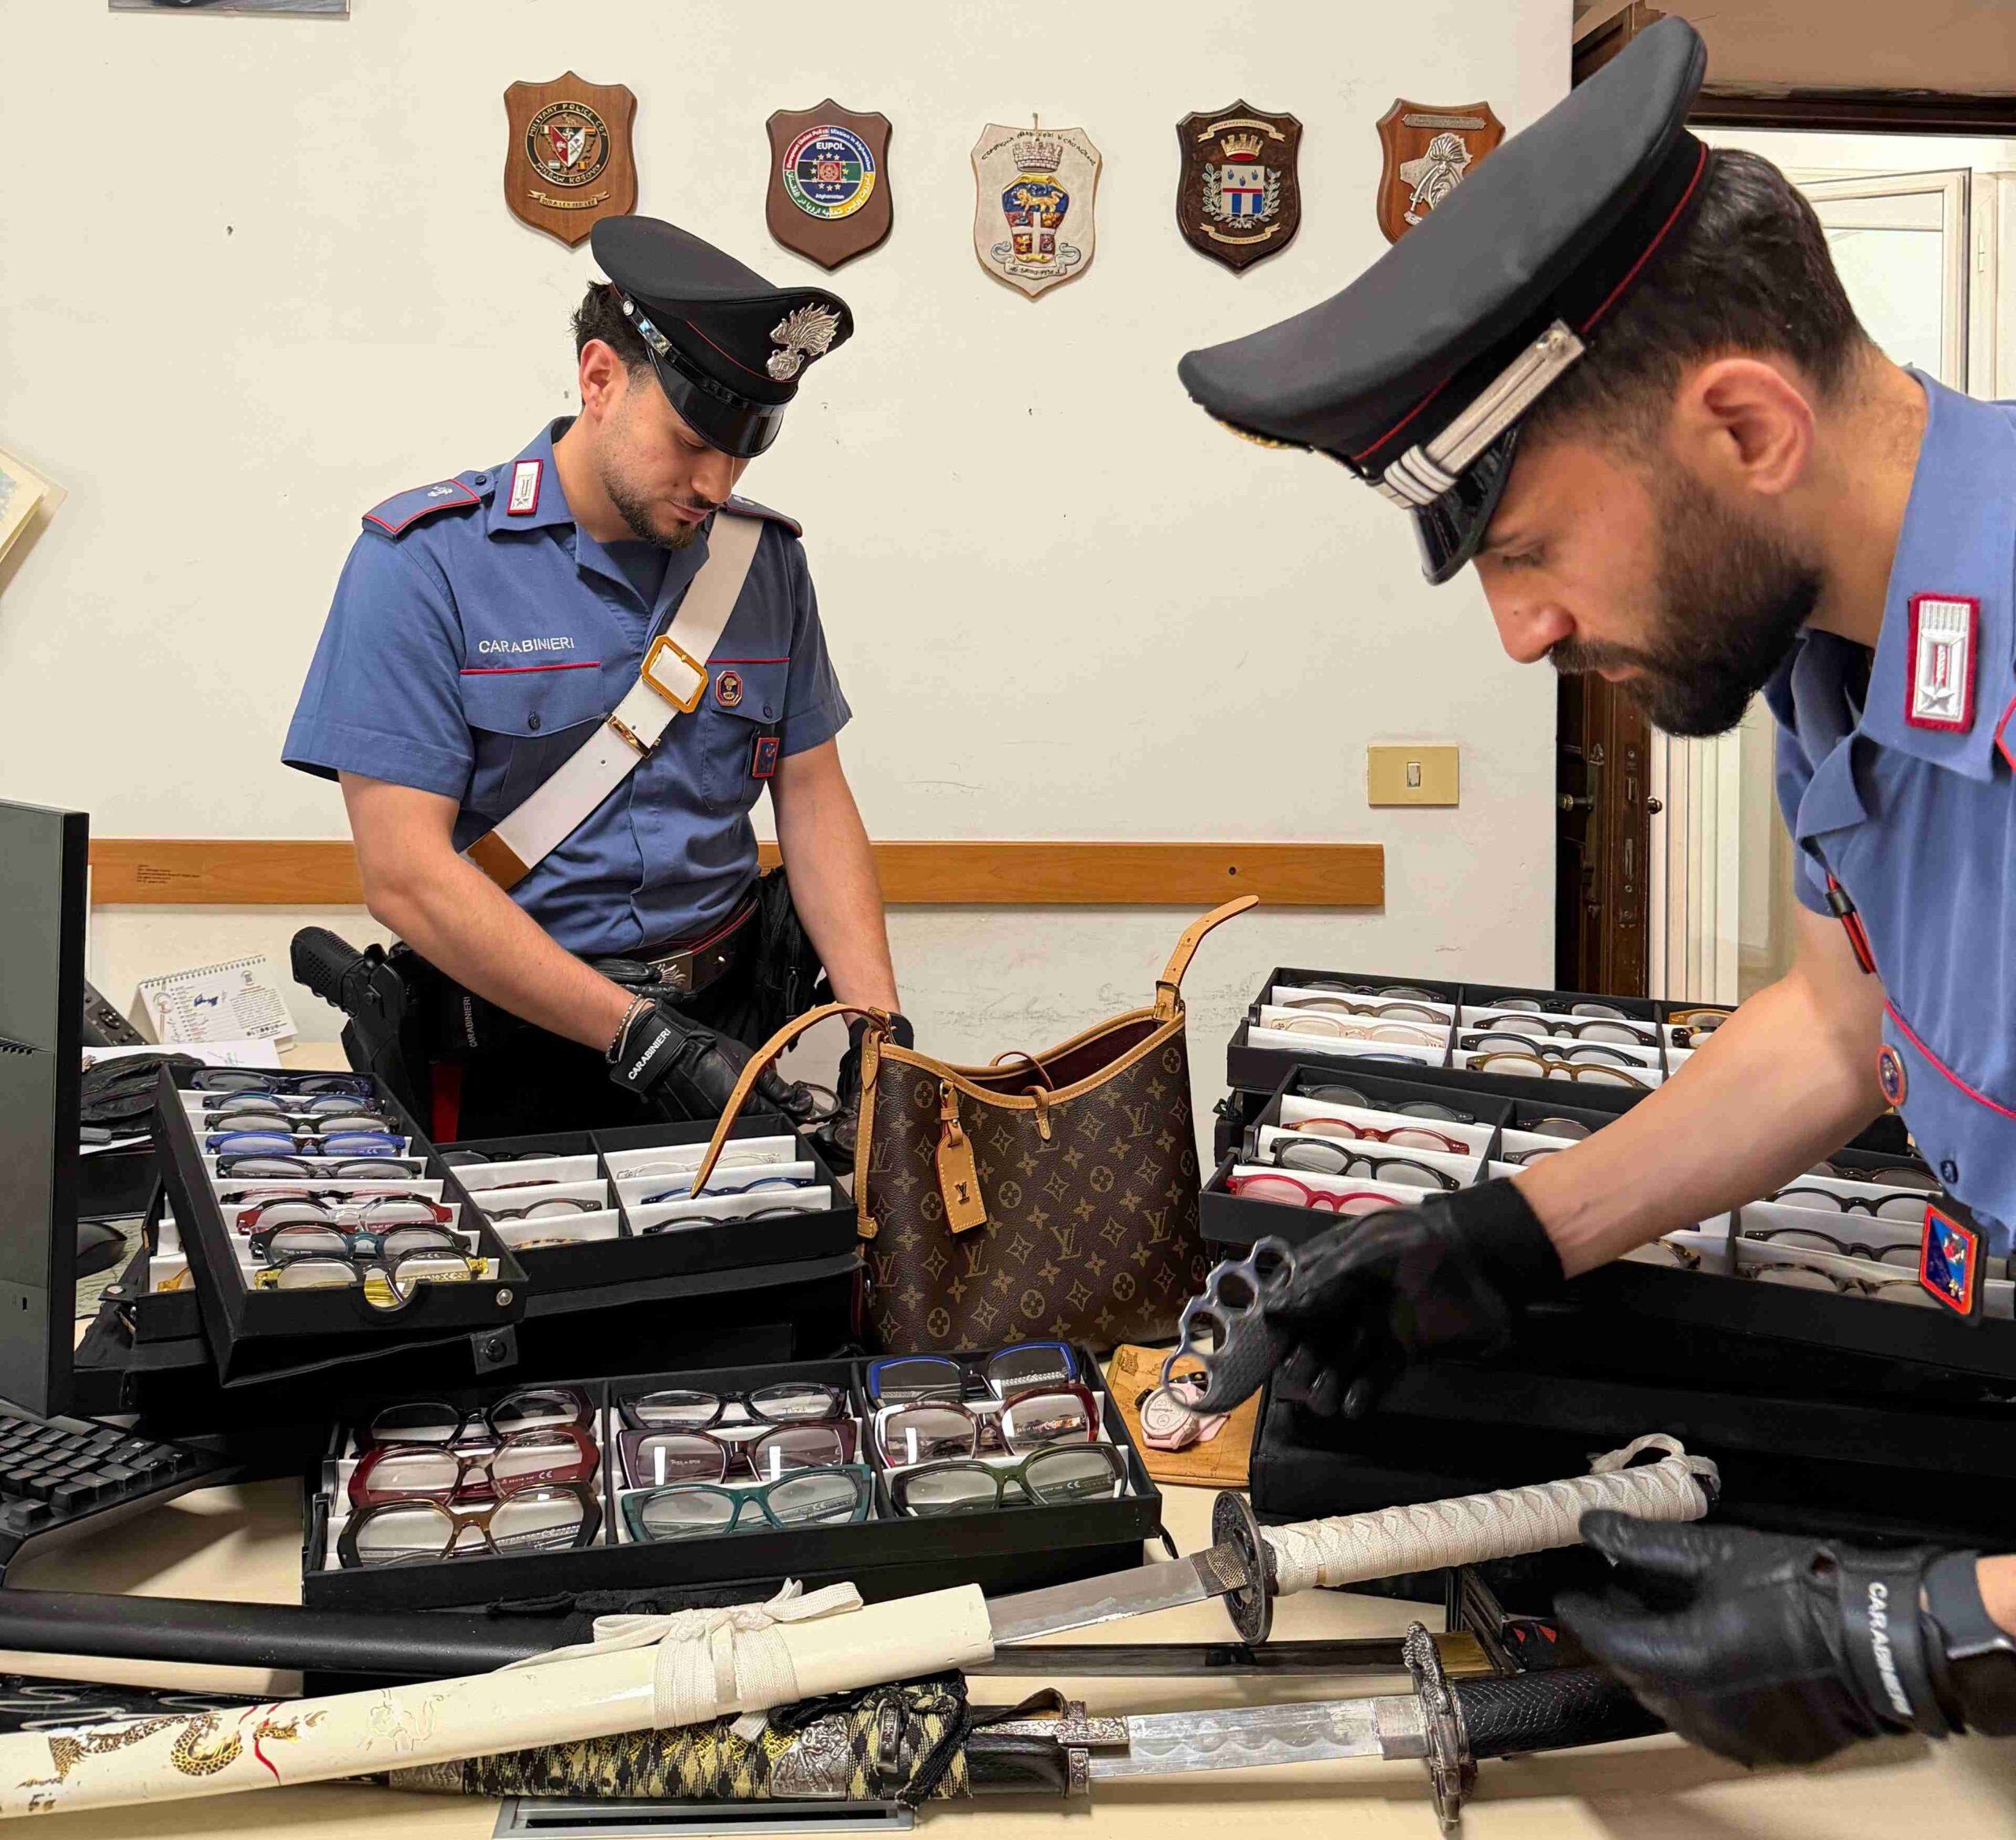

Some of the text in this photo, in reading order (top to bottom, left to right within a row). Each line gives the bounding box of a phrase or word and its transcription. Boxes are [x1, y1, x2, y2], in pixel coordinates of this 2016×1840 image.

[528, 105, 558, 137] MILITARY
[562, 103, 593, 118] POLICE
[797, 134, 812, 146] Union
[816, 142, 846, 150] EUPOL
[569, 164, 600, 183] KOSOVO
[478, 636, 575, 653] CARABINIERI
[463, 996, 478, 1048] CARABINIERI
[628, 1027, 672, 1080] CARABINIERI
